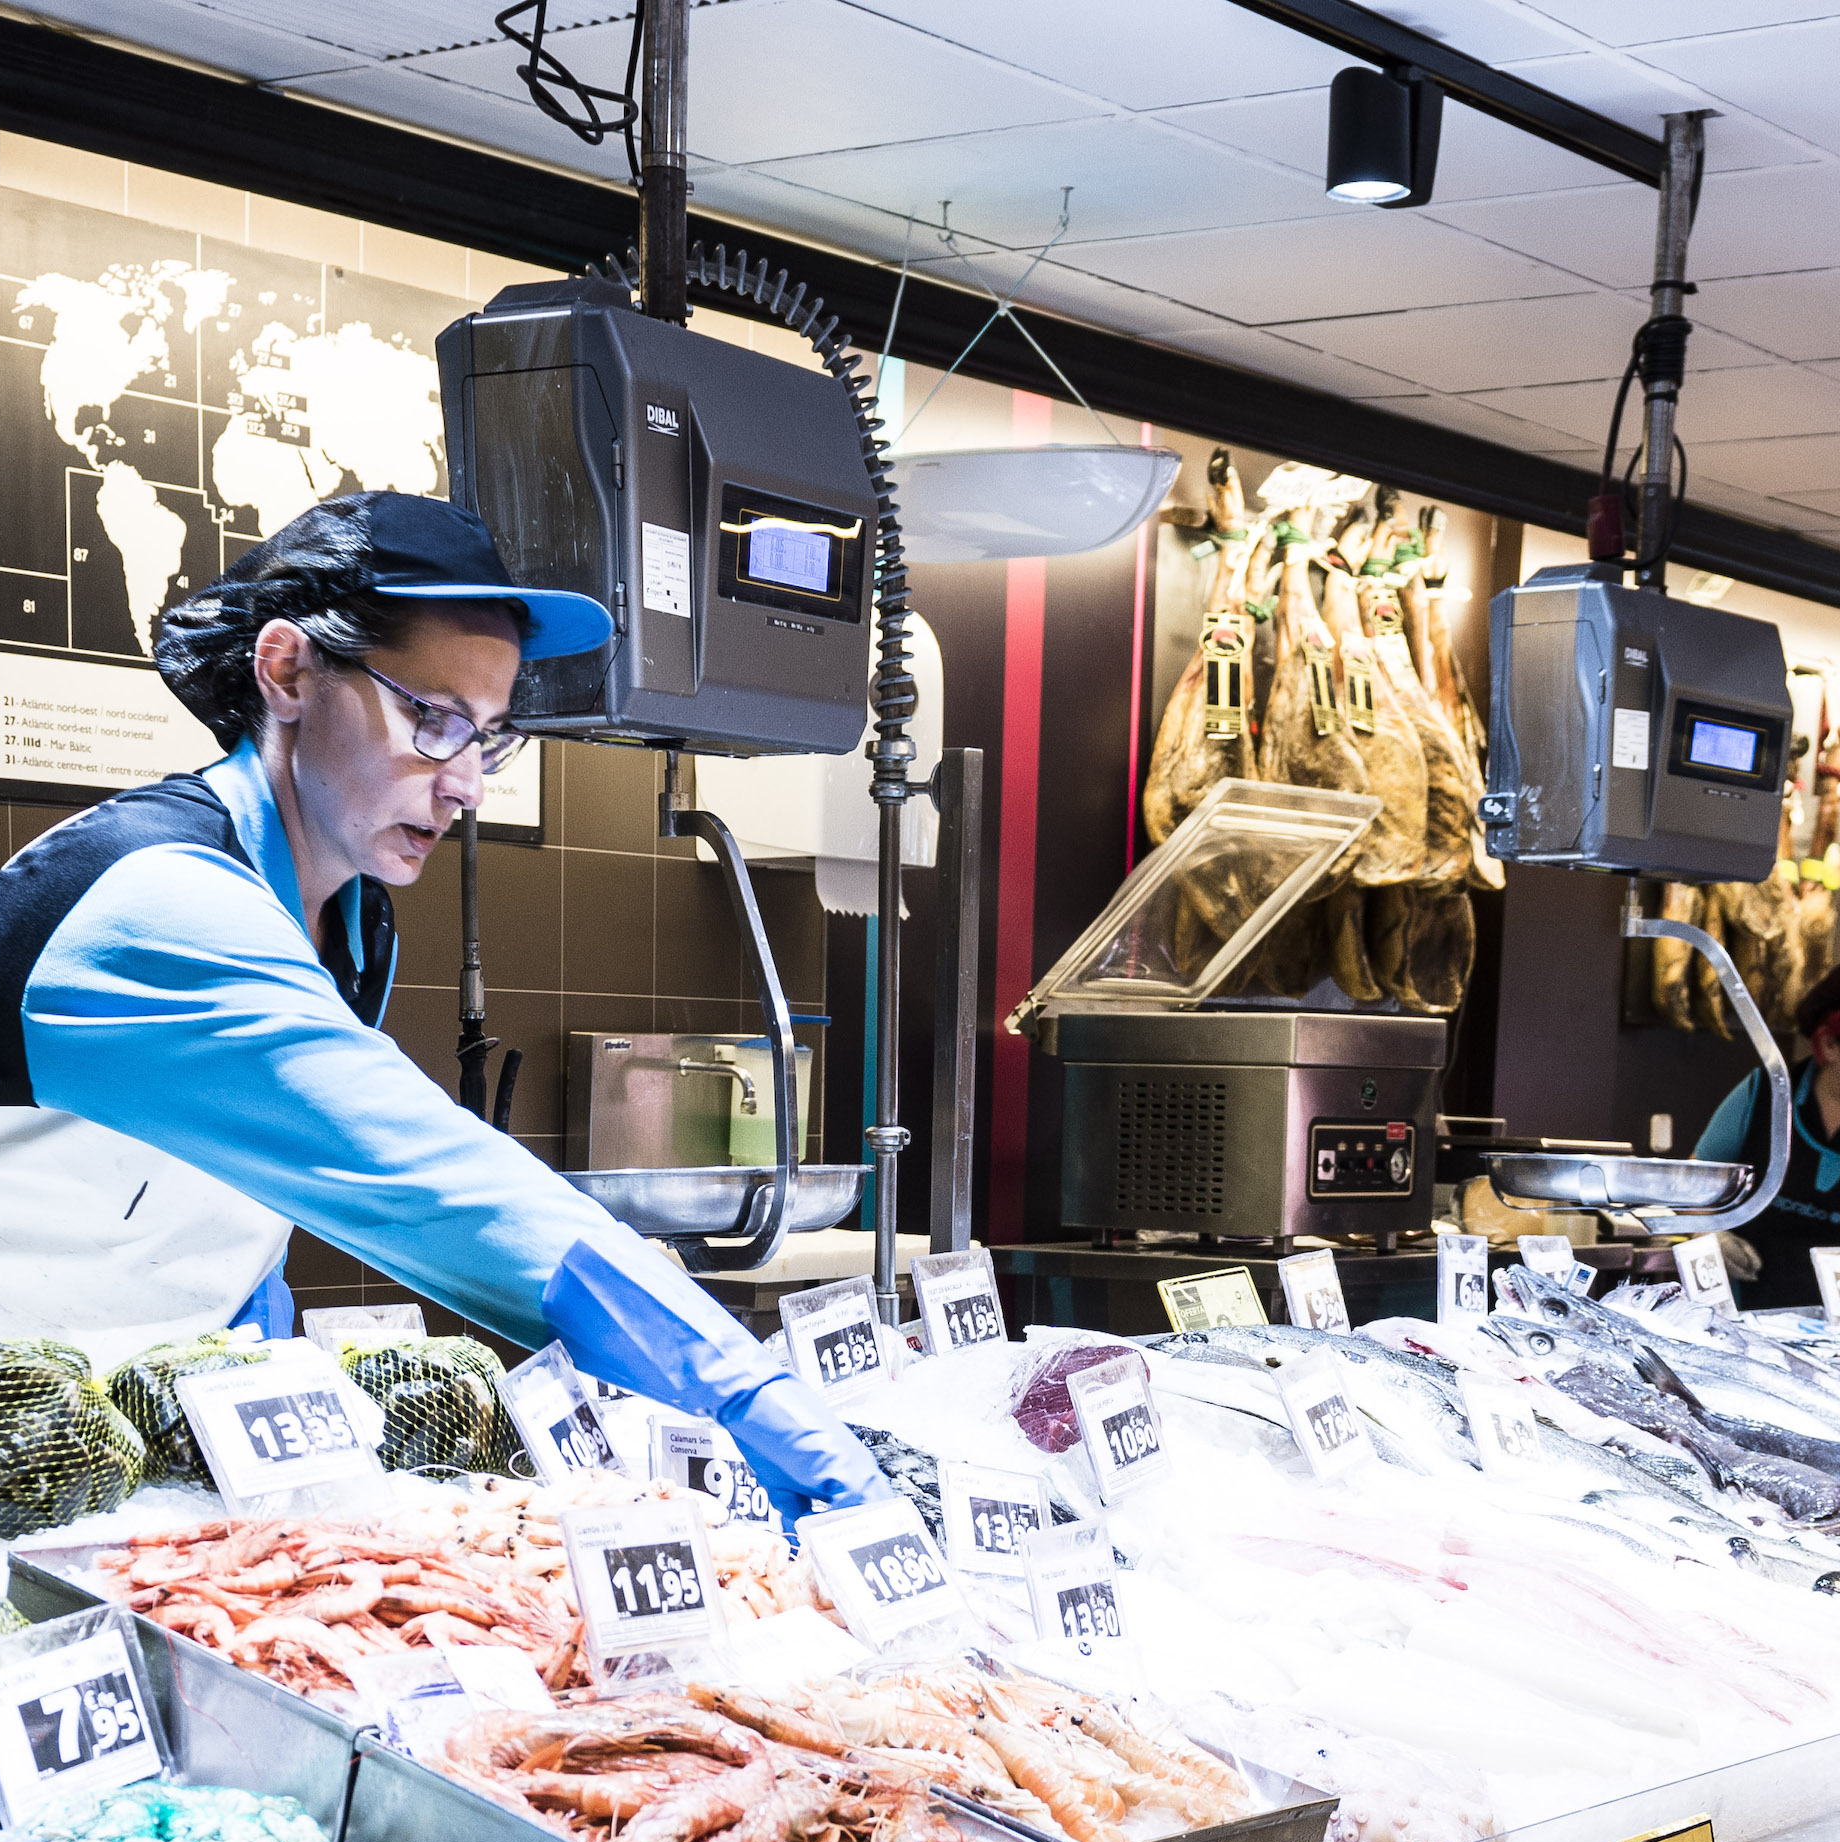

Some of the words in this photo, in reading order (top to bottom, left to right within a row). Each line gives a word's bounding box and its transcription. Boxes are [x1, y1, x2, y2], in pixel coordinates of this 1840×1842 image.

[164, 373, 177, 388] 21
[647, 404, 679, 429] DIBAL
[143, 429, 156, 444] 31
[220, 508, 234, 522] 34
[73, 548, 88, 562] 87
[176, 576, 189, 589] 41
[23, 599, 36, 613] 81
[106, 709, 126, 720] nord
[128, 711, 169, 724] occidental
[57, 722, 92, 734] nord-est
[101, 728, 120, 738] nord
[122, 730, 154, 741] oriental
[50, 740, 66, 751] Mar
[57, 760, 98, 773] centre-est
[106, 766, 131, 776] centre
[820, 1342, 877, 1380] 13,95
[249, 1411, 353, 1457] 13,35
[670, 1445, 697, 1455] Conserva
[704, 1459, 769, 1520] 9,50
[612, 1564, 701, 1614] 11,95
[40, 1686, 141, 1764] 7,95
